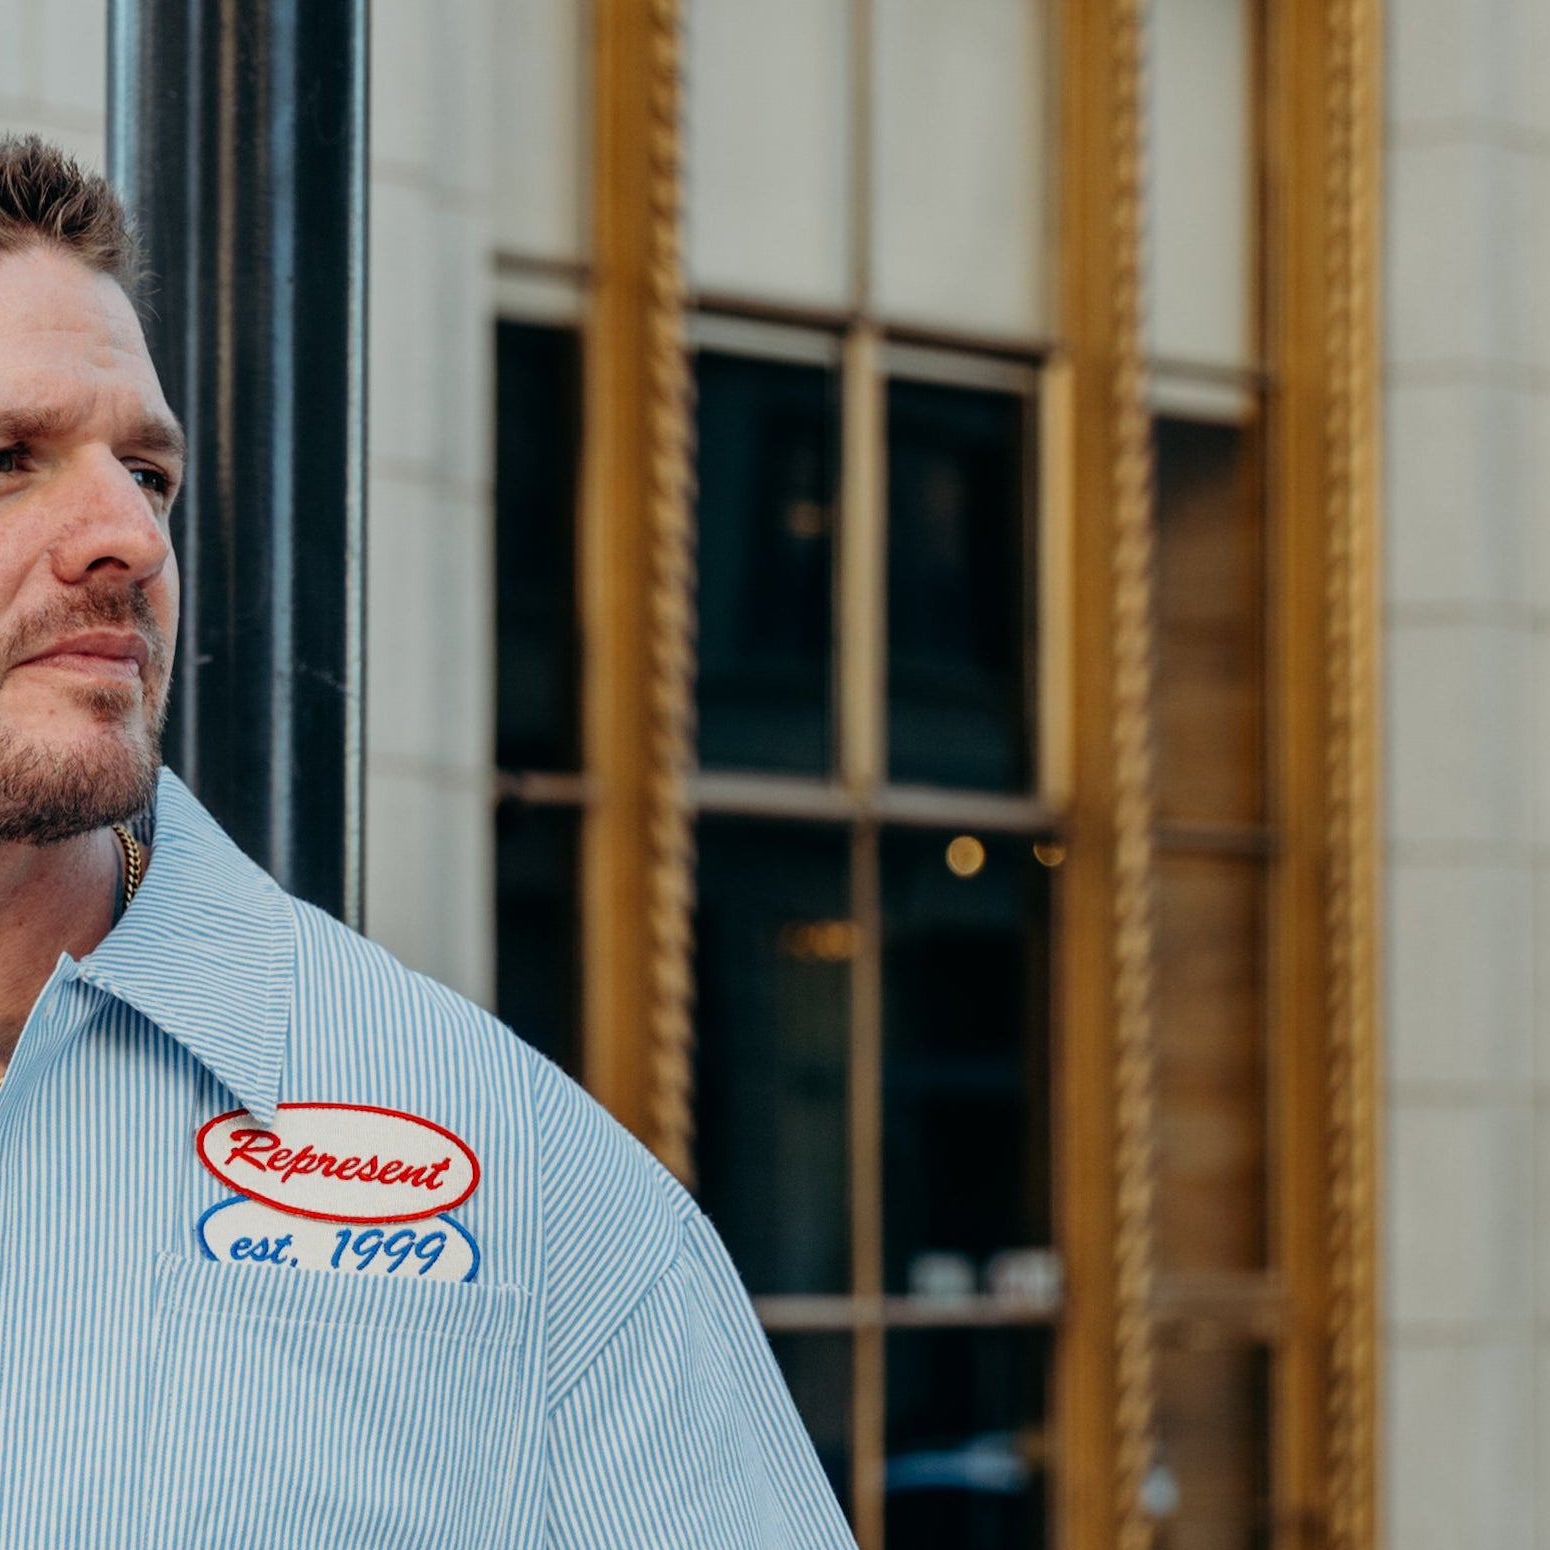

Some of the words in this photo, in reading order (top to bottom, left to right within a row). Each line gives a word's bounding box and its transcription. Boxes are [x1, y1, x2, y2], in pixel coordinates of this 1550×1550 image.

[224, 1128, 452, 1191] Represent
[230, 1233, 298, 1268] est.
[330, 1228, 447, 1276] 1999
